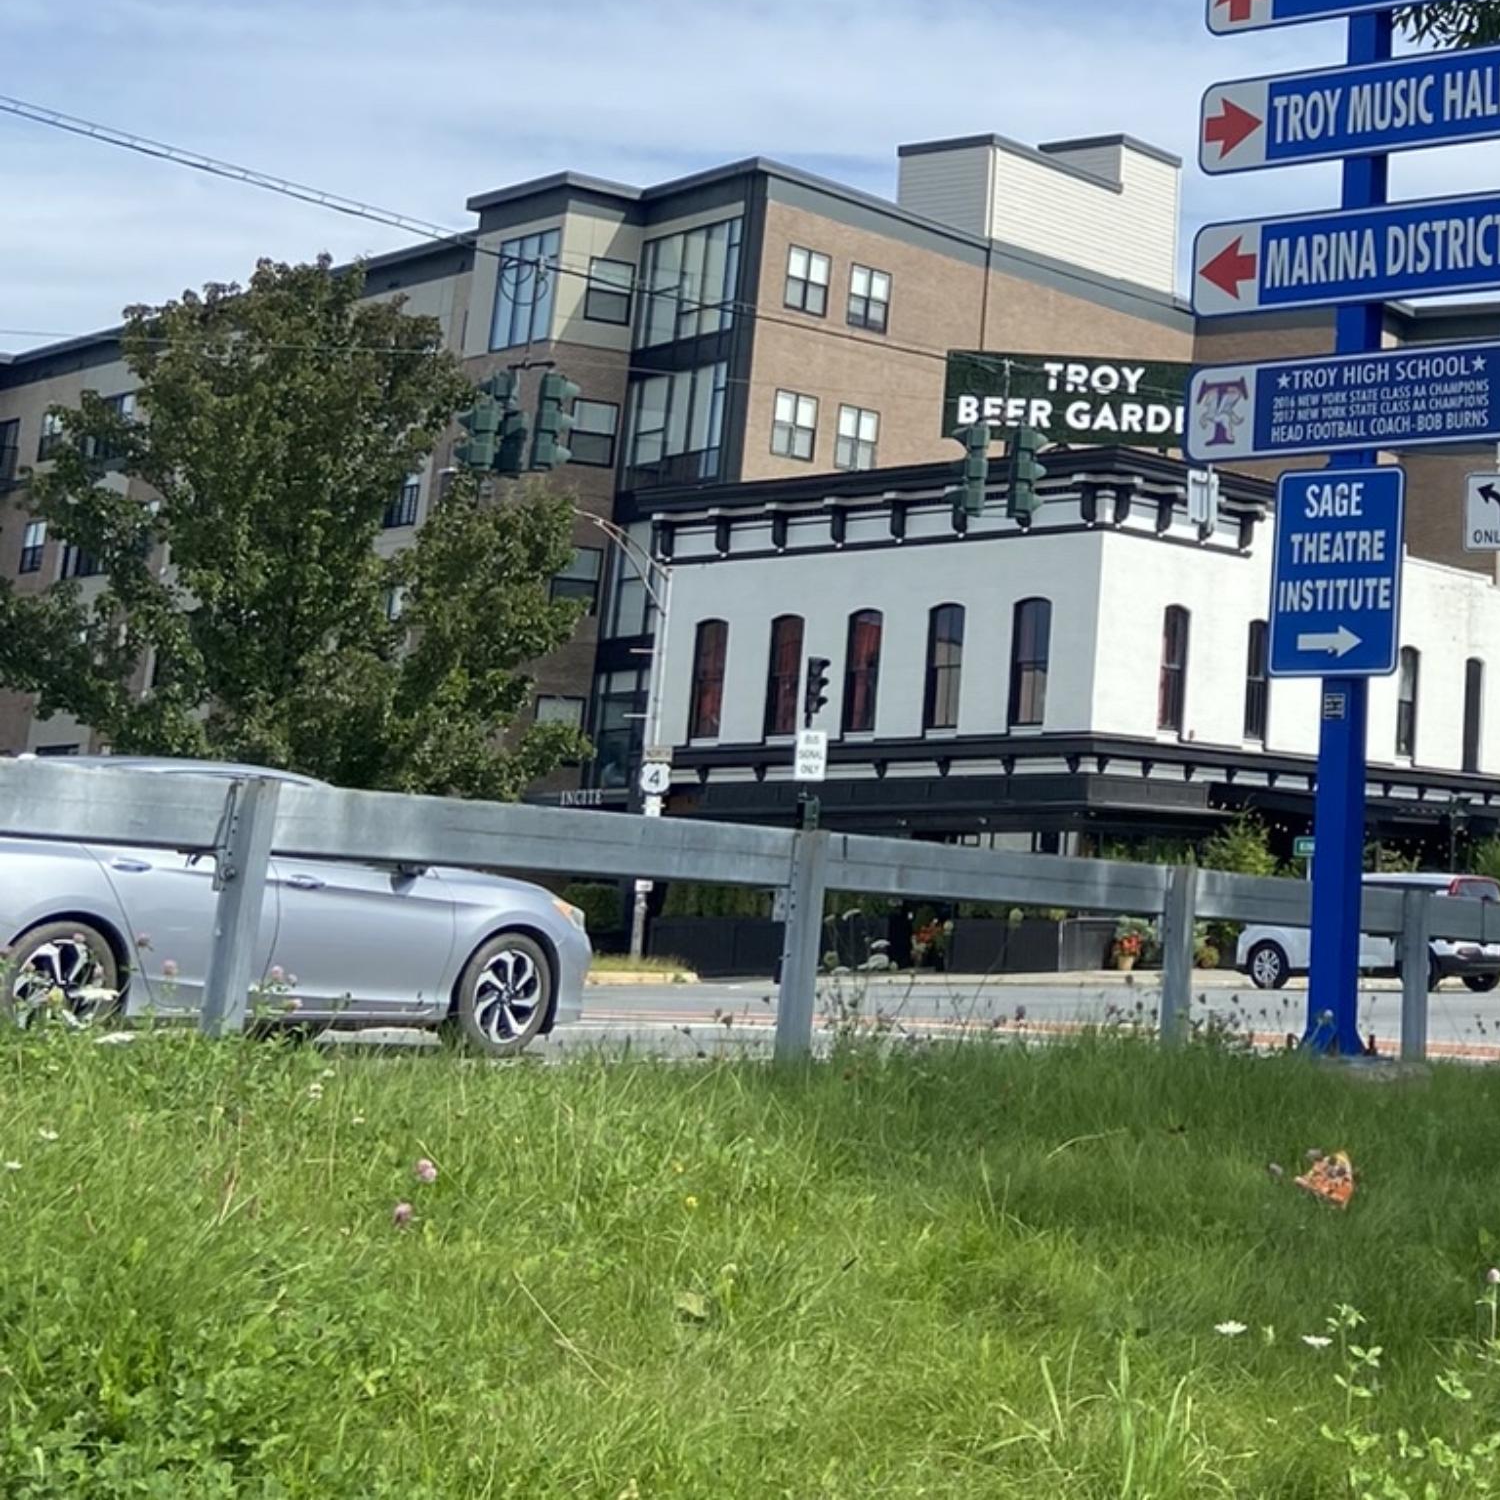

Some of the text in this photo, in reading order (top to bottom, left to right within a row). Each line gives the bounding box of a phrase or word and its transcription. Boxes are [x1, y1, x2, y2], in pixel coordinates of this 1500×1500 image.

[1273, 88, 1342, 144] TROY
[1347, 76, 1434, 134] MUSIC
[1265, 229, 1377, 289] MARINA
[1044, 363, 1145, 394] TROY
[1292, 356, 1470, 389] TROY HIGH SCHOOL
[1273, 393, 1489, 423] 2017 NEW YORK STATE CLASS AA CHAMPIONS
[1298, 393, 1319, 407] NEW
[1322, 391, 1347, 405] YORK
[1349, 388, 1378, 403] STATE
[1380, 385, 1410, 399] CLASS
[1413, 384, 1427, 397] AA
[1429, 379, 1489, 396] CHAMPIONS
[957, 396, 1184, 434] BEER GARD
[1271, 424, 1303, 442] HEAD
[1306, 419, 1366, 440] FOOTBALL
[1446, 409, 1489, 430] BURNS
[1304, 482, 1364, 518] SAGE
[1290, 530, 1385, 565] THEATRE
[1278, 577, 1391, 613] INSTITUTE
[648, 770, 660, 787] 4
